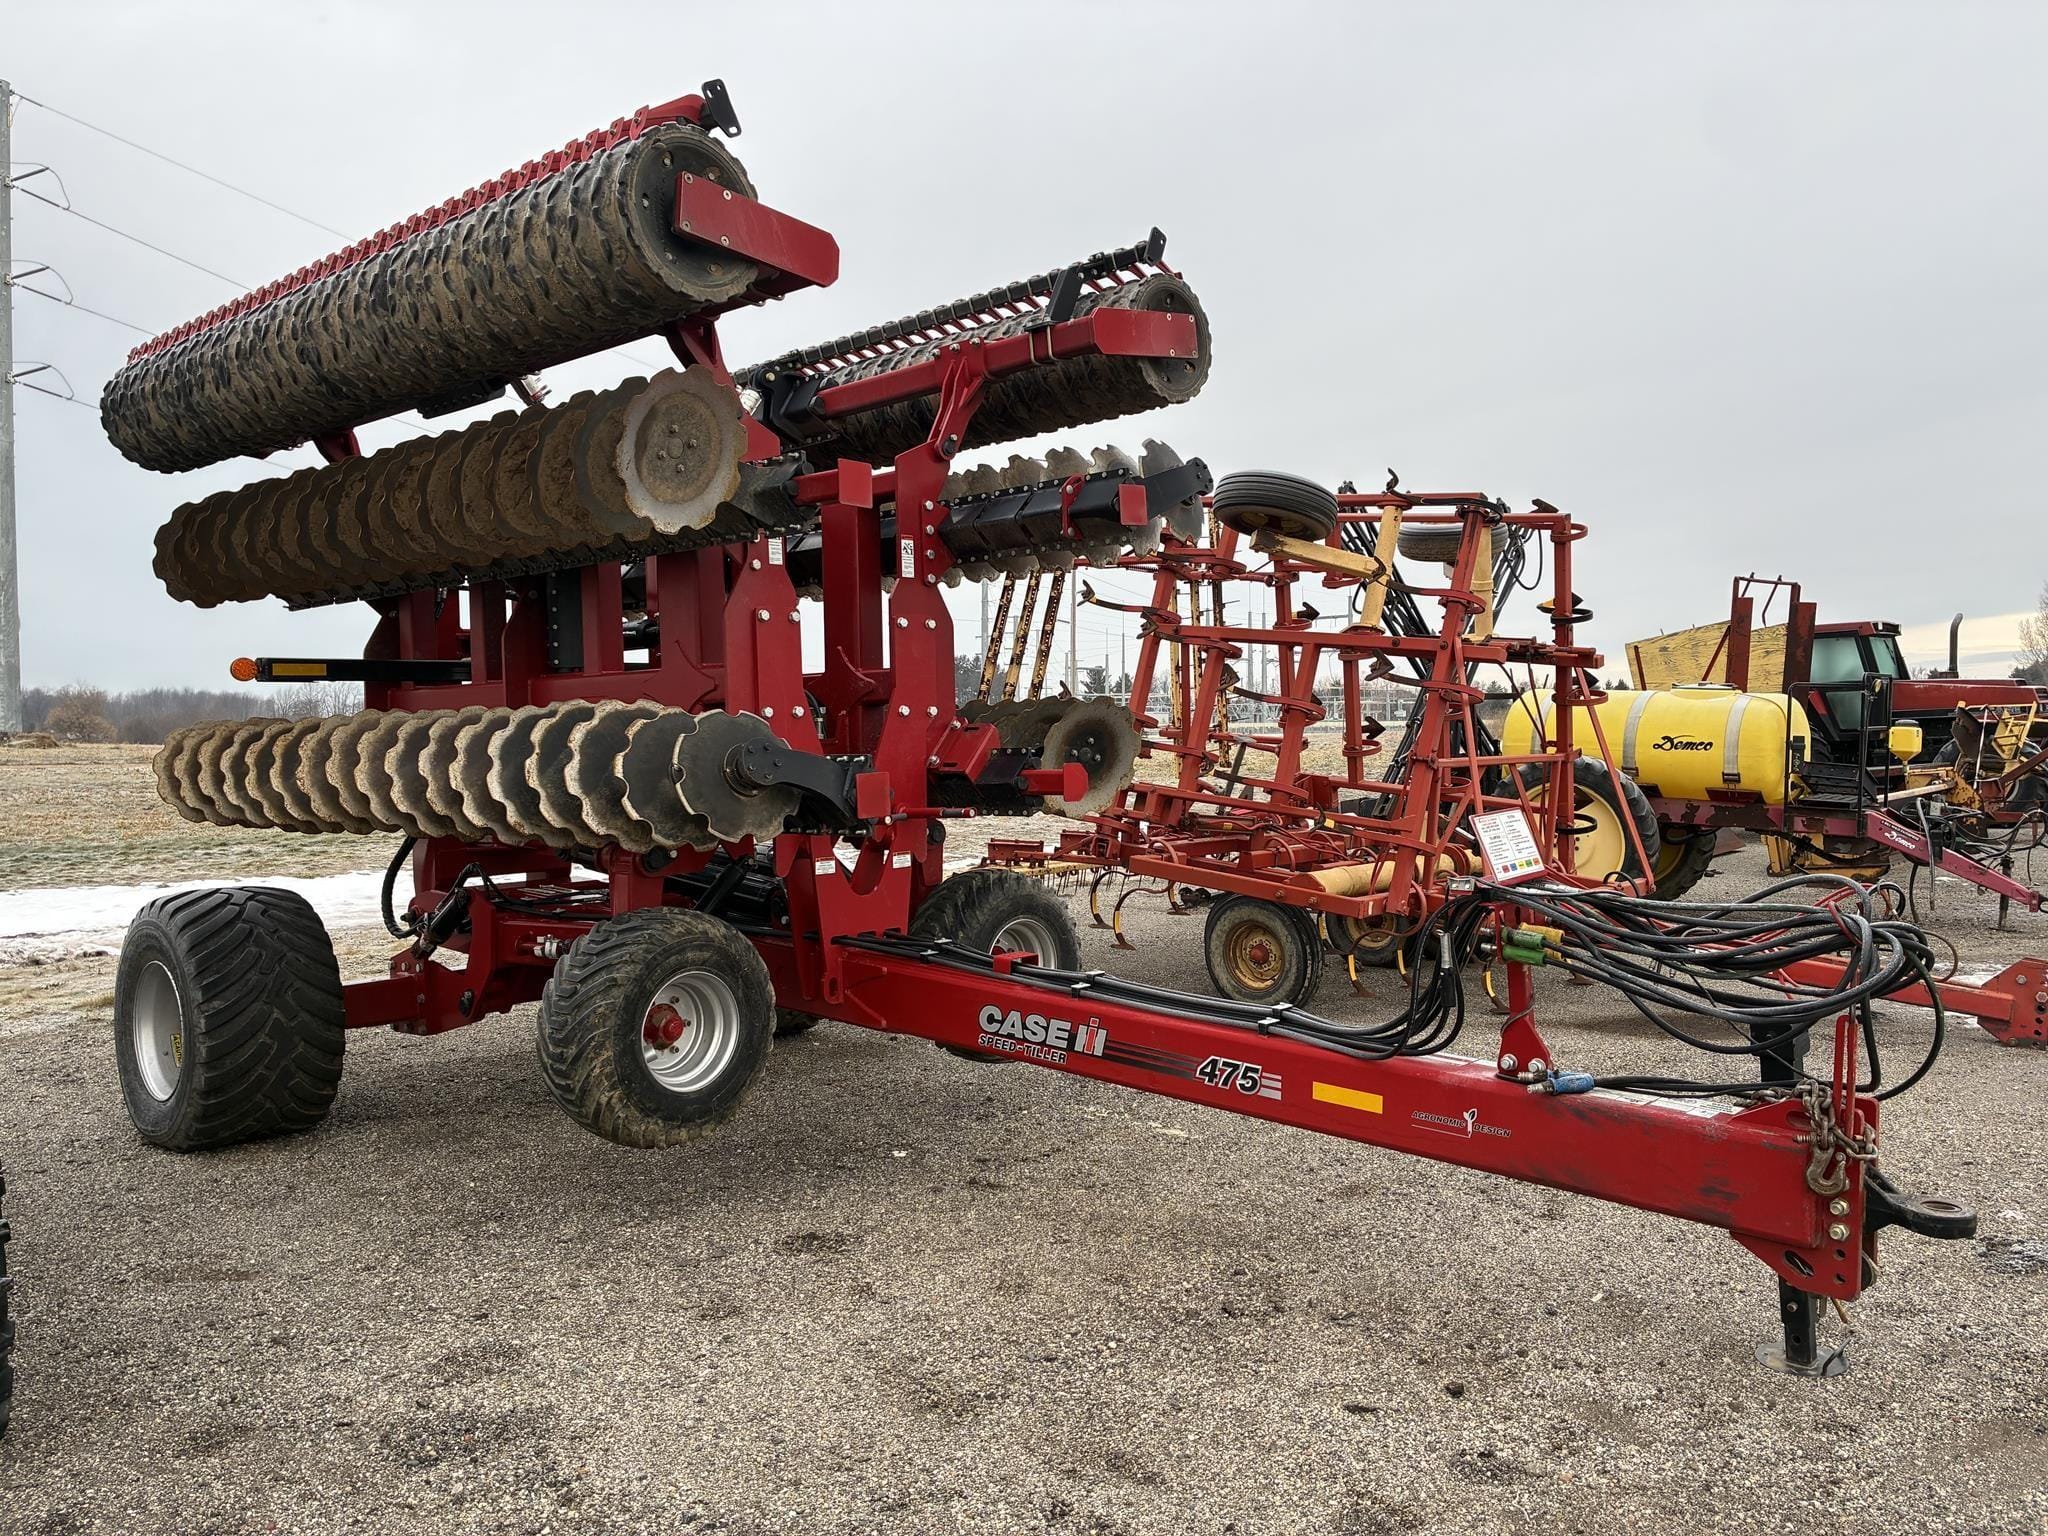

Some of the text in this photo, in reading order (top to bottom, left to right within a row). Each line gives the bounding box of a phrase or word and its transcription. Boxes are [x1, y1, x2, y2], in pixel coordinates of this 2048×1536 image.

[1652, 734, 1714, 752] Demco
[1884, 830, 1916, 850] Demco
[978, 1004, 1072, 1049] CASE
[978, 1033, 1068, 1065] SPEED-TILLER
[1195, 1055, 1262, 1095] 475
[1411, 1110, 1511, 1138] AGRONOMIC DESIGN
